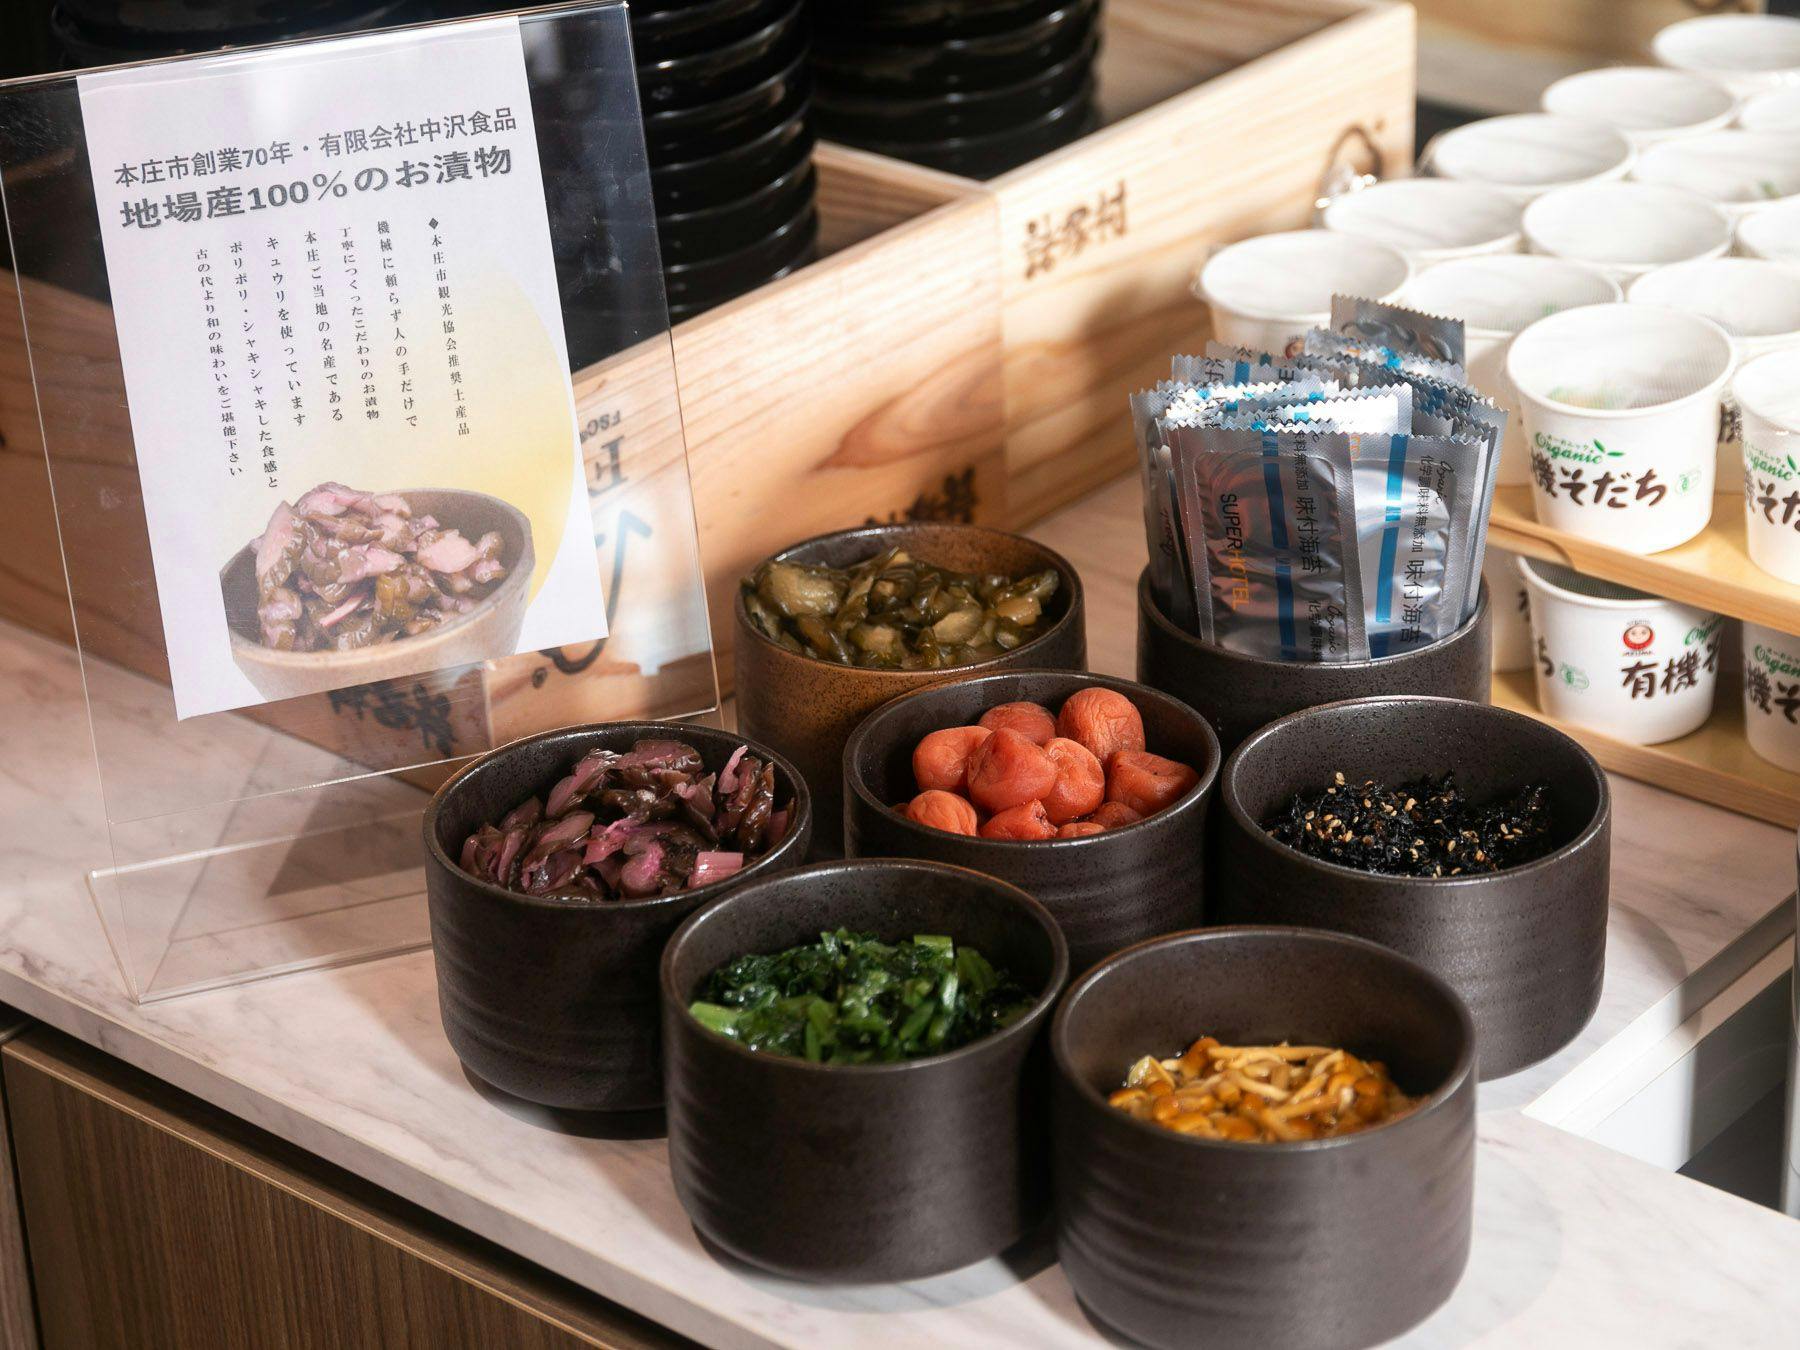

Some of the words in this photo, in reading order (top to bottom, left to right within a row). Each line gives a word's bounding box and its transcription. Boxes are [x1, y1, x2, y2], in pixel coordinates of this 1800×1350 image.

[114, 107, 517, 189] 本庄市創業70年・有限会社中沢食品
[120, 144, 512, 230] 地場産100%のお漬物
[266, 237, 306, 426] キュウリを使っています
[1296, 496, 1323, 574] 味付海苔
[1325, 605, 1343, 653] Organic
[1399, 558, 1425, 644] 味付海苔
